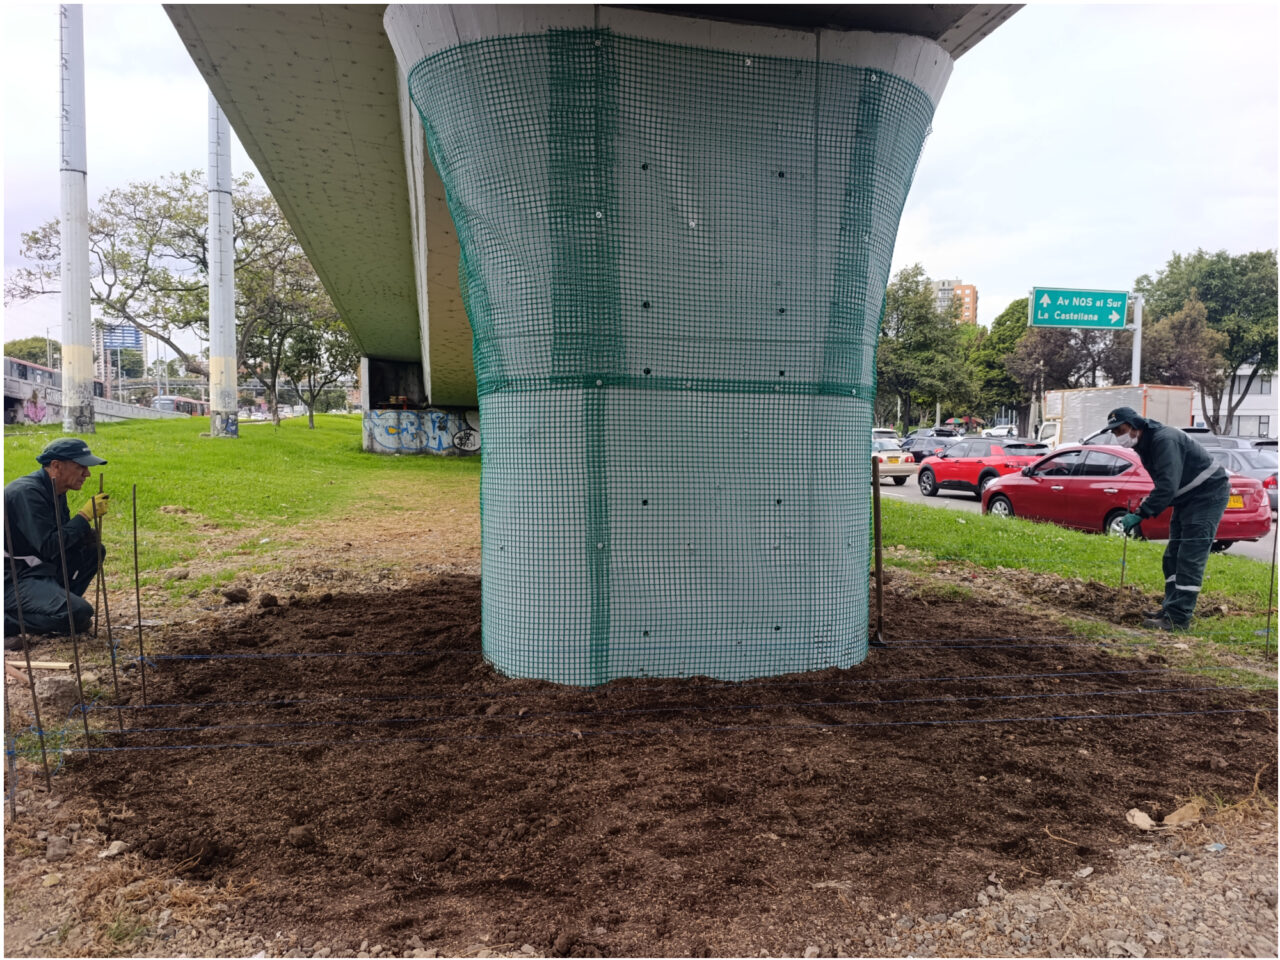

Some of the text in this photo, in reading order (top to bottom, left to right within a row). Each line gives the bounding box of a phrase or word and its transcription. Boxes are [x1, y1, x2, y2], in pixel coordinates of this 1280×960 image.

[1056, 296, 1122, 308] Av NOS al Sur
[1037, 310, 1099, 321] La Castellana
